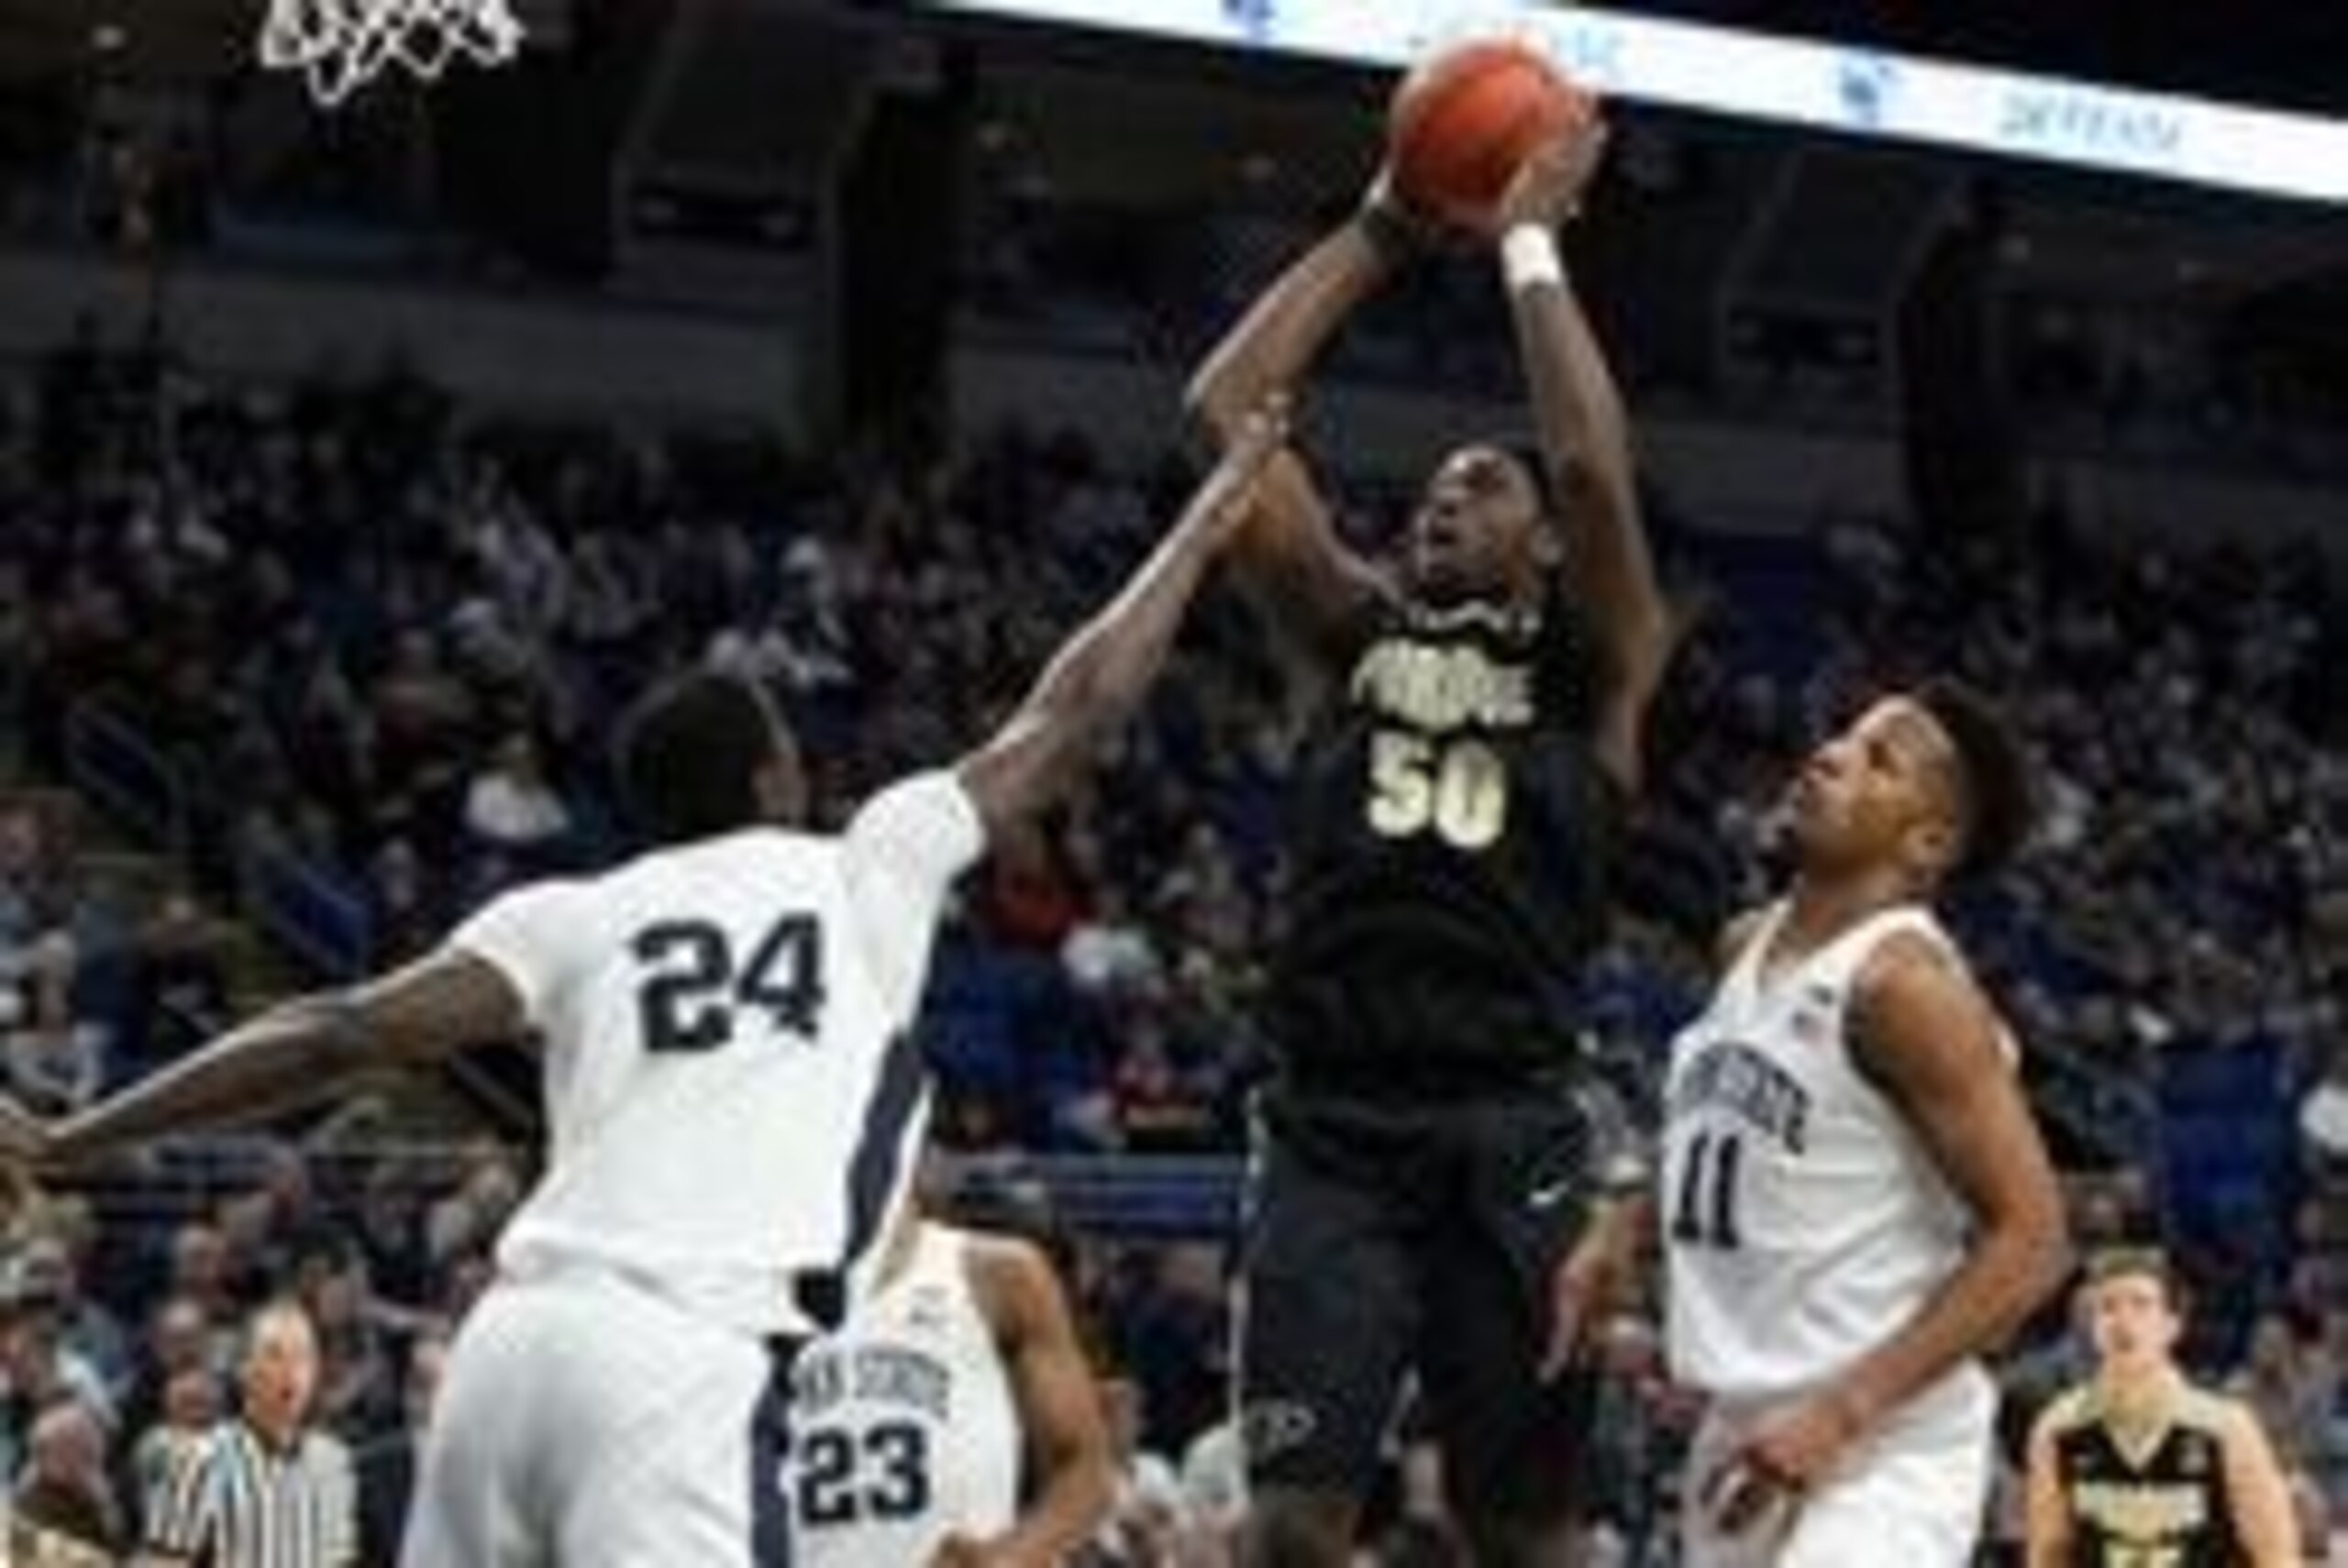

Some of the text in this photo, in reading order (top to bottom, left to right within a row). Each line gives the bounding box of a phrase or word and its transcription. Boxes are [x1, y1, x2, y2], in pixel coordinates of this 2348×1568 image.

[1368, 731, 1506, 849] 50
[629, 911, 827, 1054] 24
[1671, 1130, 1740, 1251] 11
[796, 1421, 930, 1527] 23
